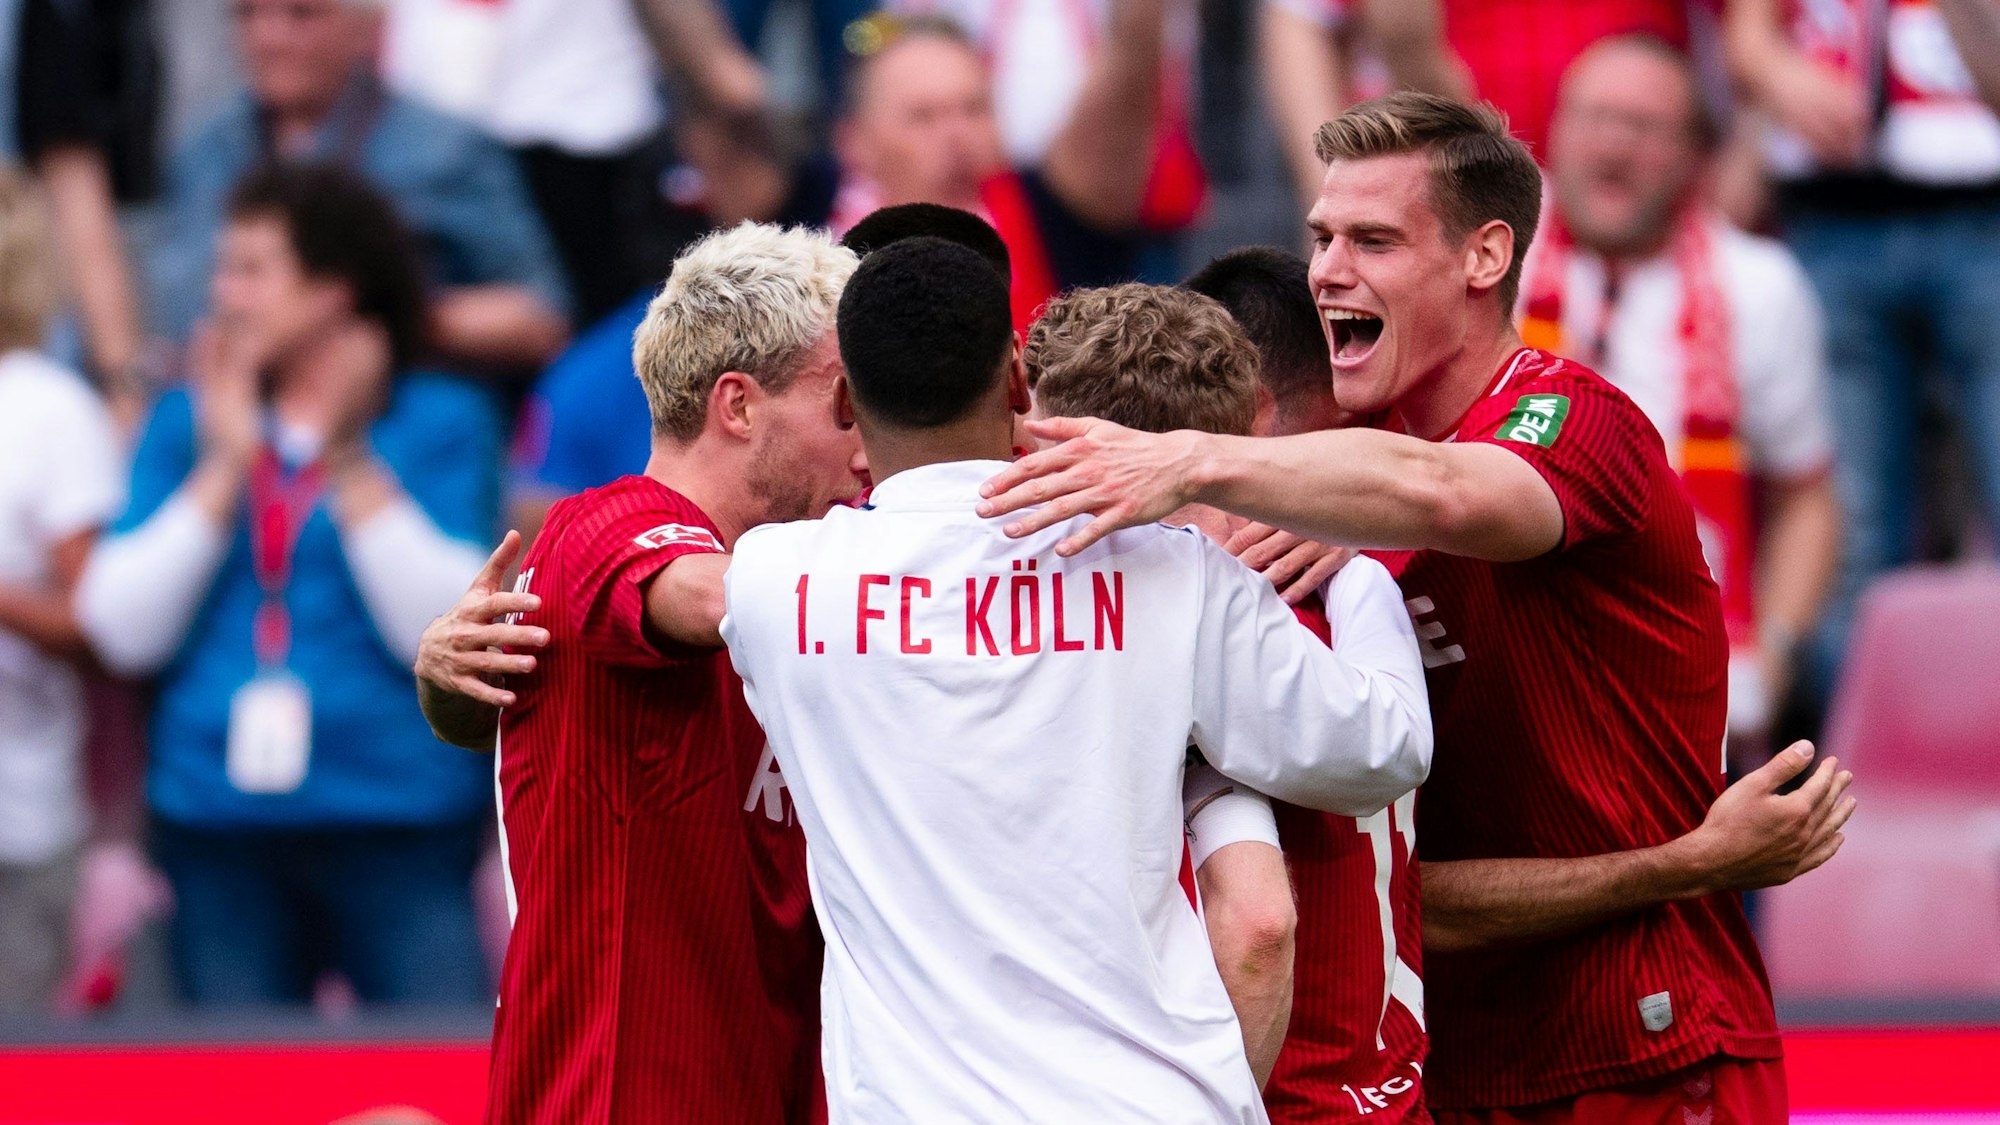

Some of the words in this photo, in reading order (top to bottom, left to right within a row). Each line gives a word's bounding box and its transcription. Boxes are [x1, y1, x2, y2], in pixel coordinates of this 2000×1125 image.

[794, 573, 825, 655] 1.
[856, 573, 932, 655] FC
[965, 558, 1124, 656] KÖLN
